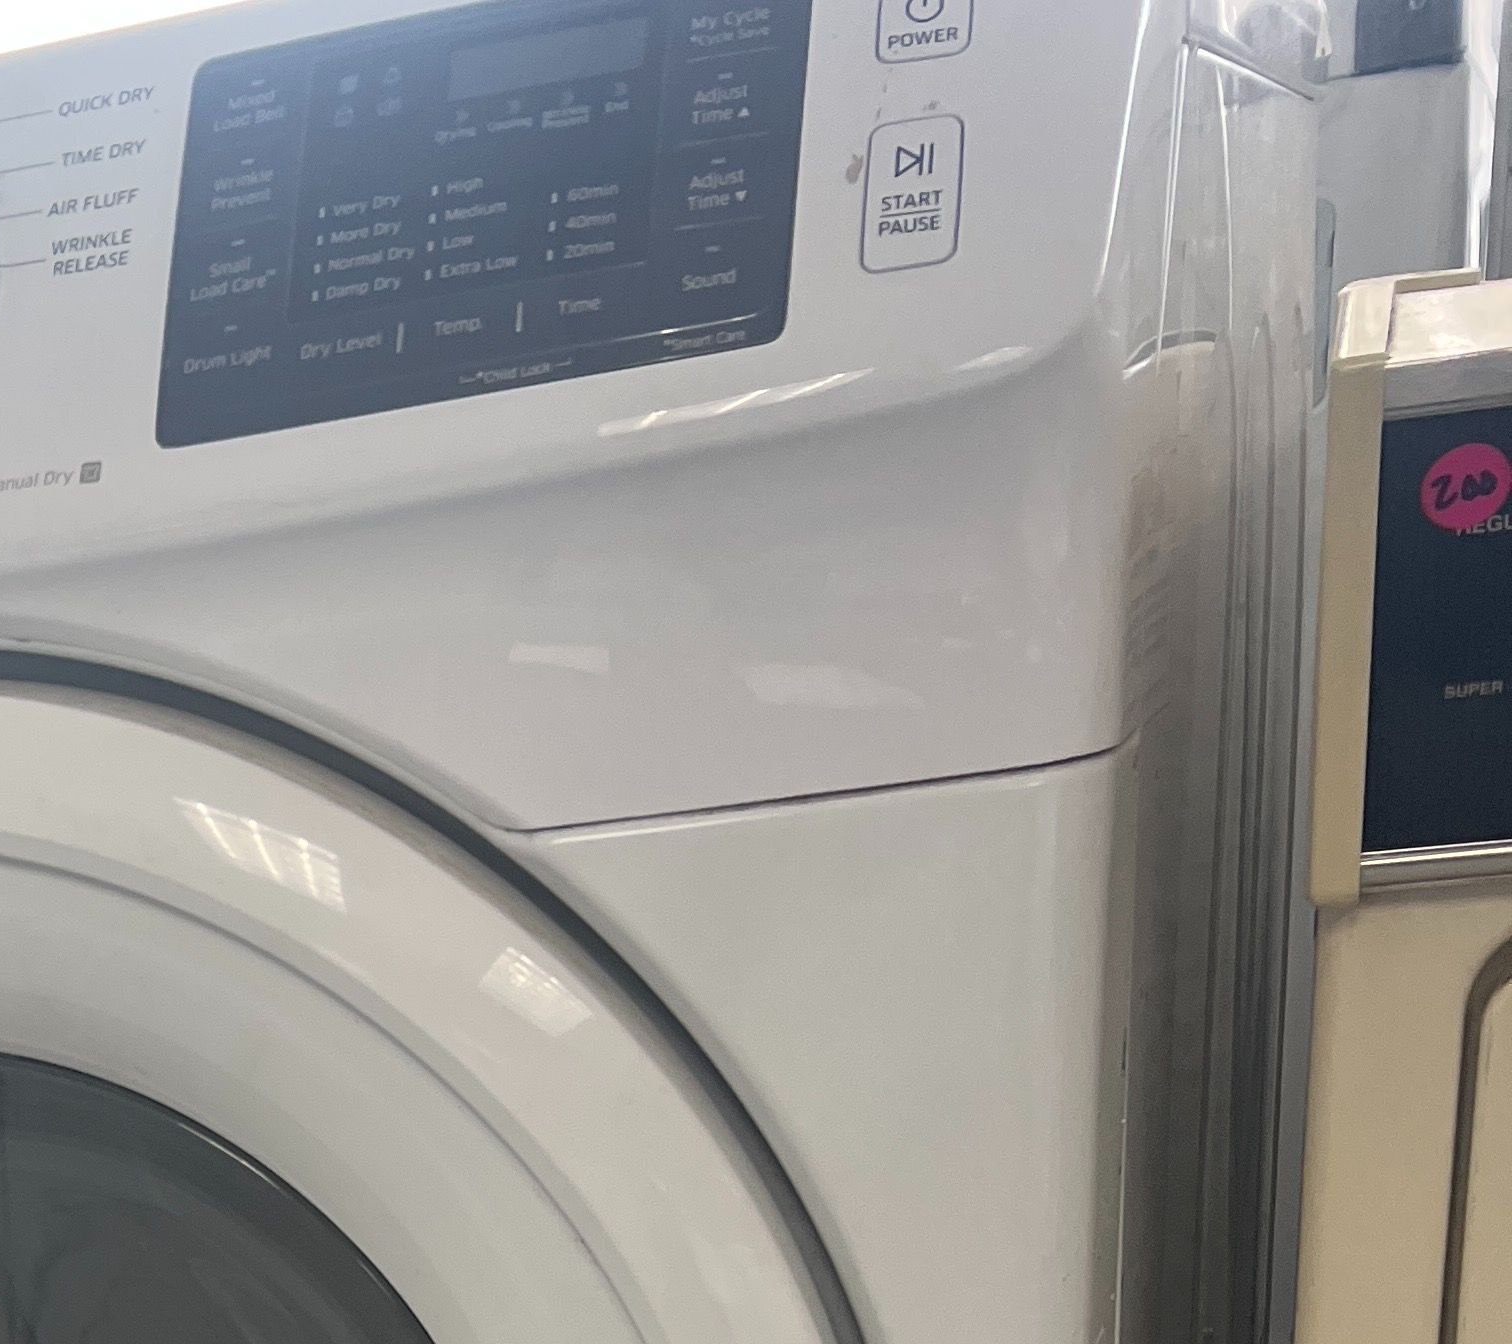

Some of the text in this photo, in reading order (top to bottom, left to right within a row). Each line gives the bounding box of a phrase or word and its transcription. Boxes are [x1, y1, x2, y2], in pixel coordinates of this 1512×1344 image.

[888, 26, 959, 49] POWER
[58, 86, 155, 117] QUICK DRY
[61, 139, 146, 166] TIME DRY
[689, 169, 745, 190] Adjust
[47, 188, 139, 217] AIR FLUFF
[333, 194, 400, 217] Very Dry
[881, 189, 943, 212] START
[330, 221, 402, 245] More Dry
[878, 215, 942, 237] PAUSE
[51, 229, 133, 255] WRINKLE
[443, 235, 474, 251] Low
[53, 251, 129, 276] RELEASE
[328, 247, 415, 272] Normal Dry
[440, 256, 519, 279] Extra Low
[373, 276, 401, 292] Dry
[681, 269, 736, 292] Sound
[300, 333, 382, 360] Dry Level
[183, 346, 272, 374] Drum Light
[43, 468, 75, 489] Dry
[1444, 680, 1503, 699] SUPER
